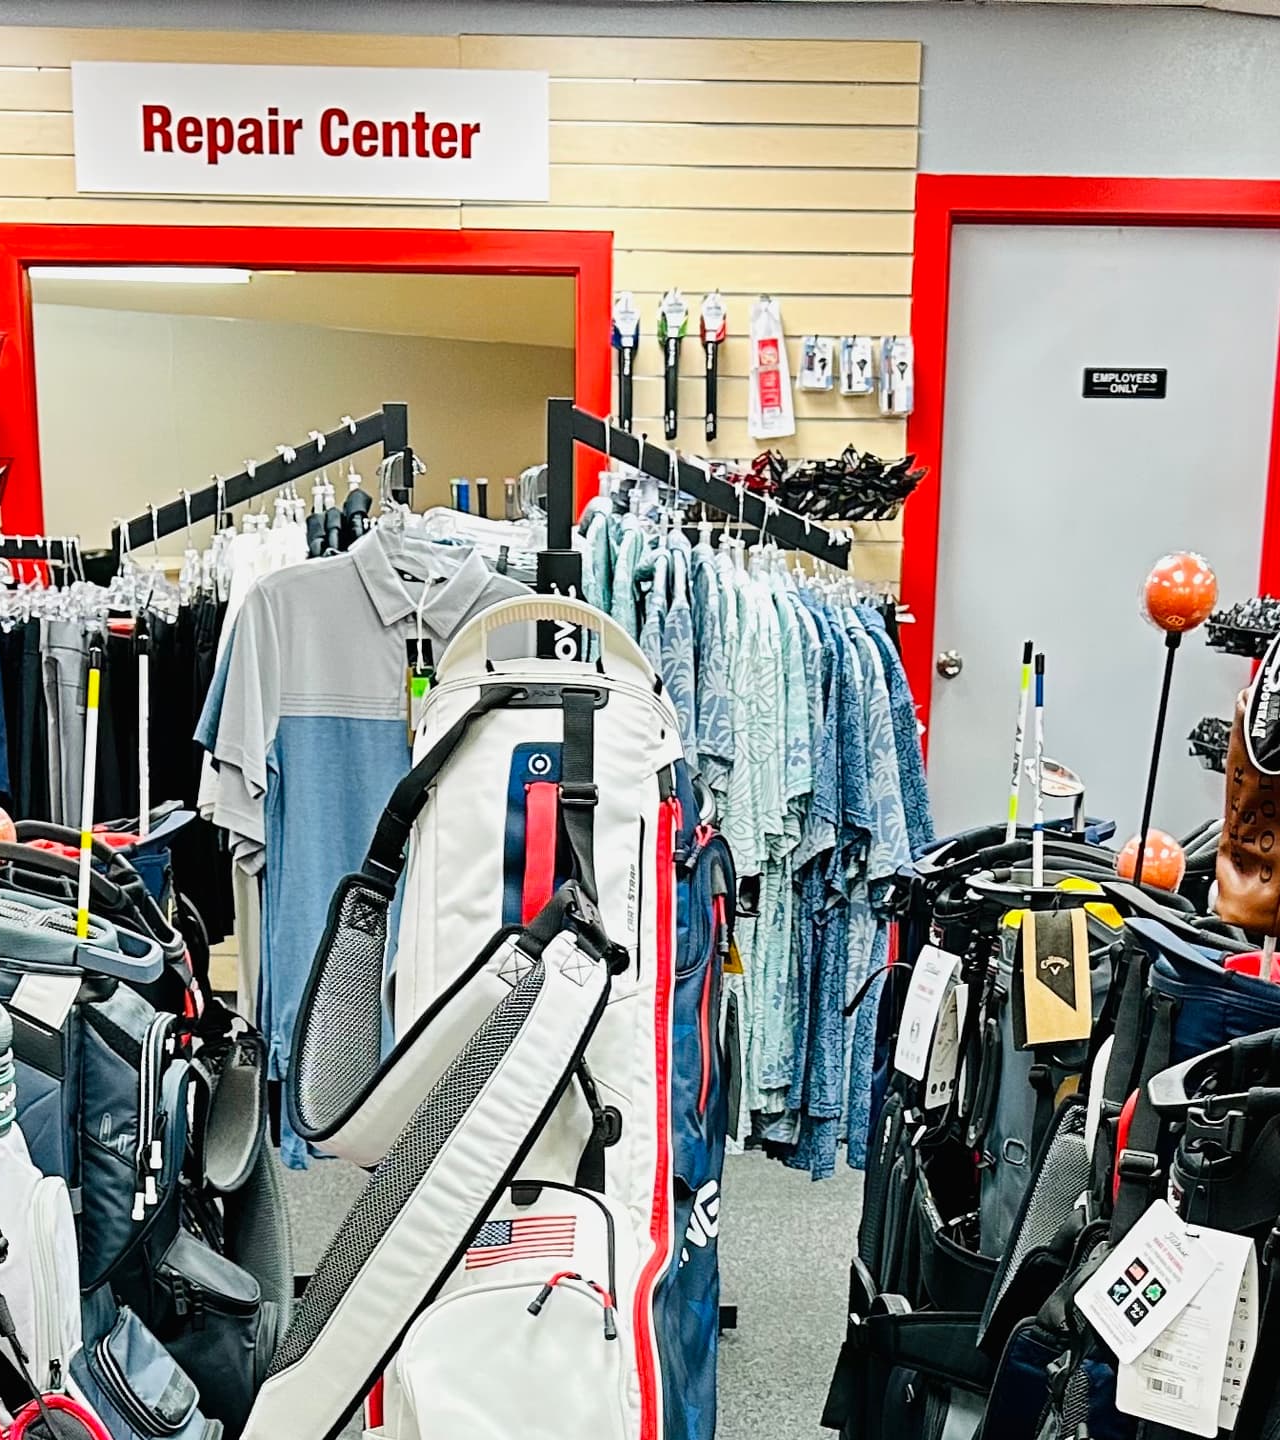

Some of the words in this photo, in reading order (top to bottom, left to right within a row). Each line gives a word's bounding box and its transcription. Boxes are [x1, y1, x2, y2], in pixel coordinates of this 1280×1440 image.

[141, 105, 304, 165] Repair
[320, 107, 482, 159] Center
[1092, 372, 1158, 384] EMPLOYEES
[1109, 383, 1139, 394] ONLY
